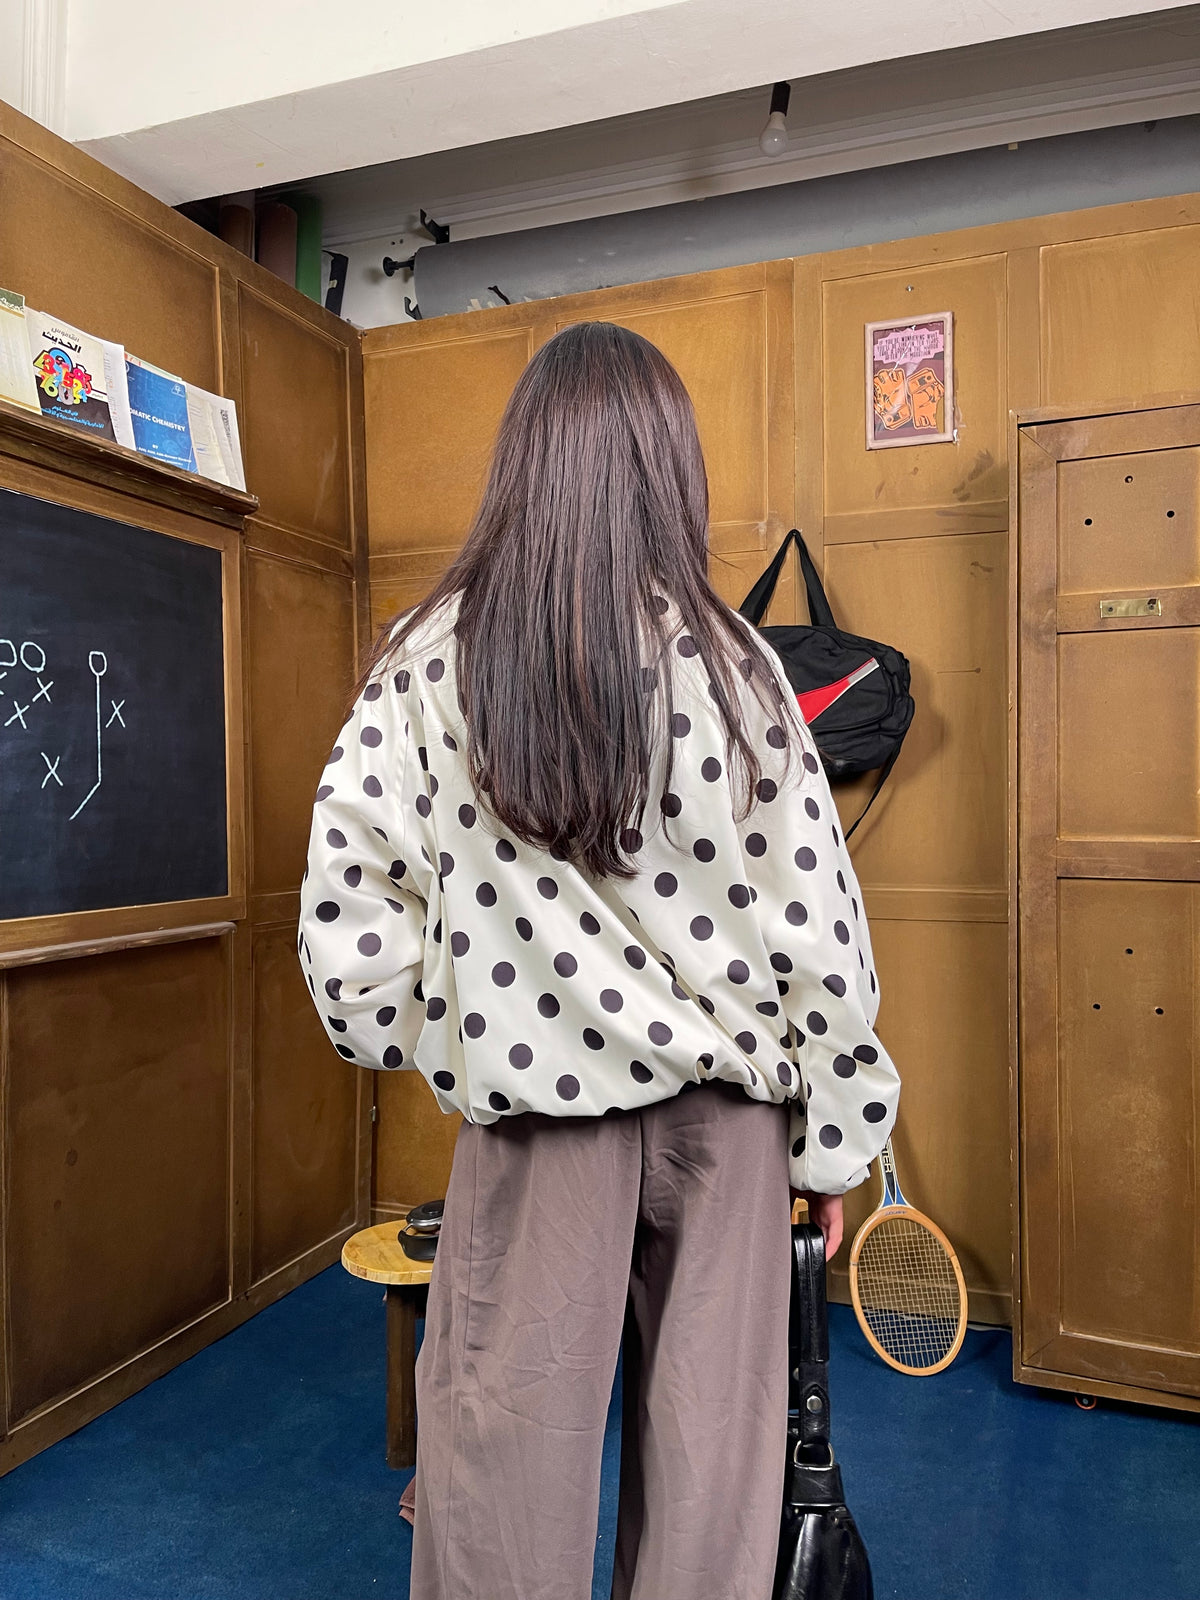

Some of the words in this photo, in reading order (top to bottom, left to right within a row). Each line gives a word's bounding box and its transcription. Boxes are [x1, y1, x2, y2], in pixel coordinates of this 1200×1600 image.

[42, 331, 82, 354] الحديث
[151, 415, 186, 432] CHEMISTRY
[881, 1144, 893, 1173] TER
